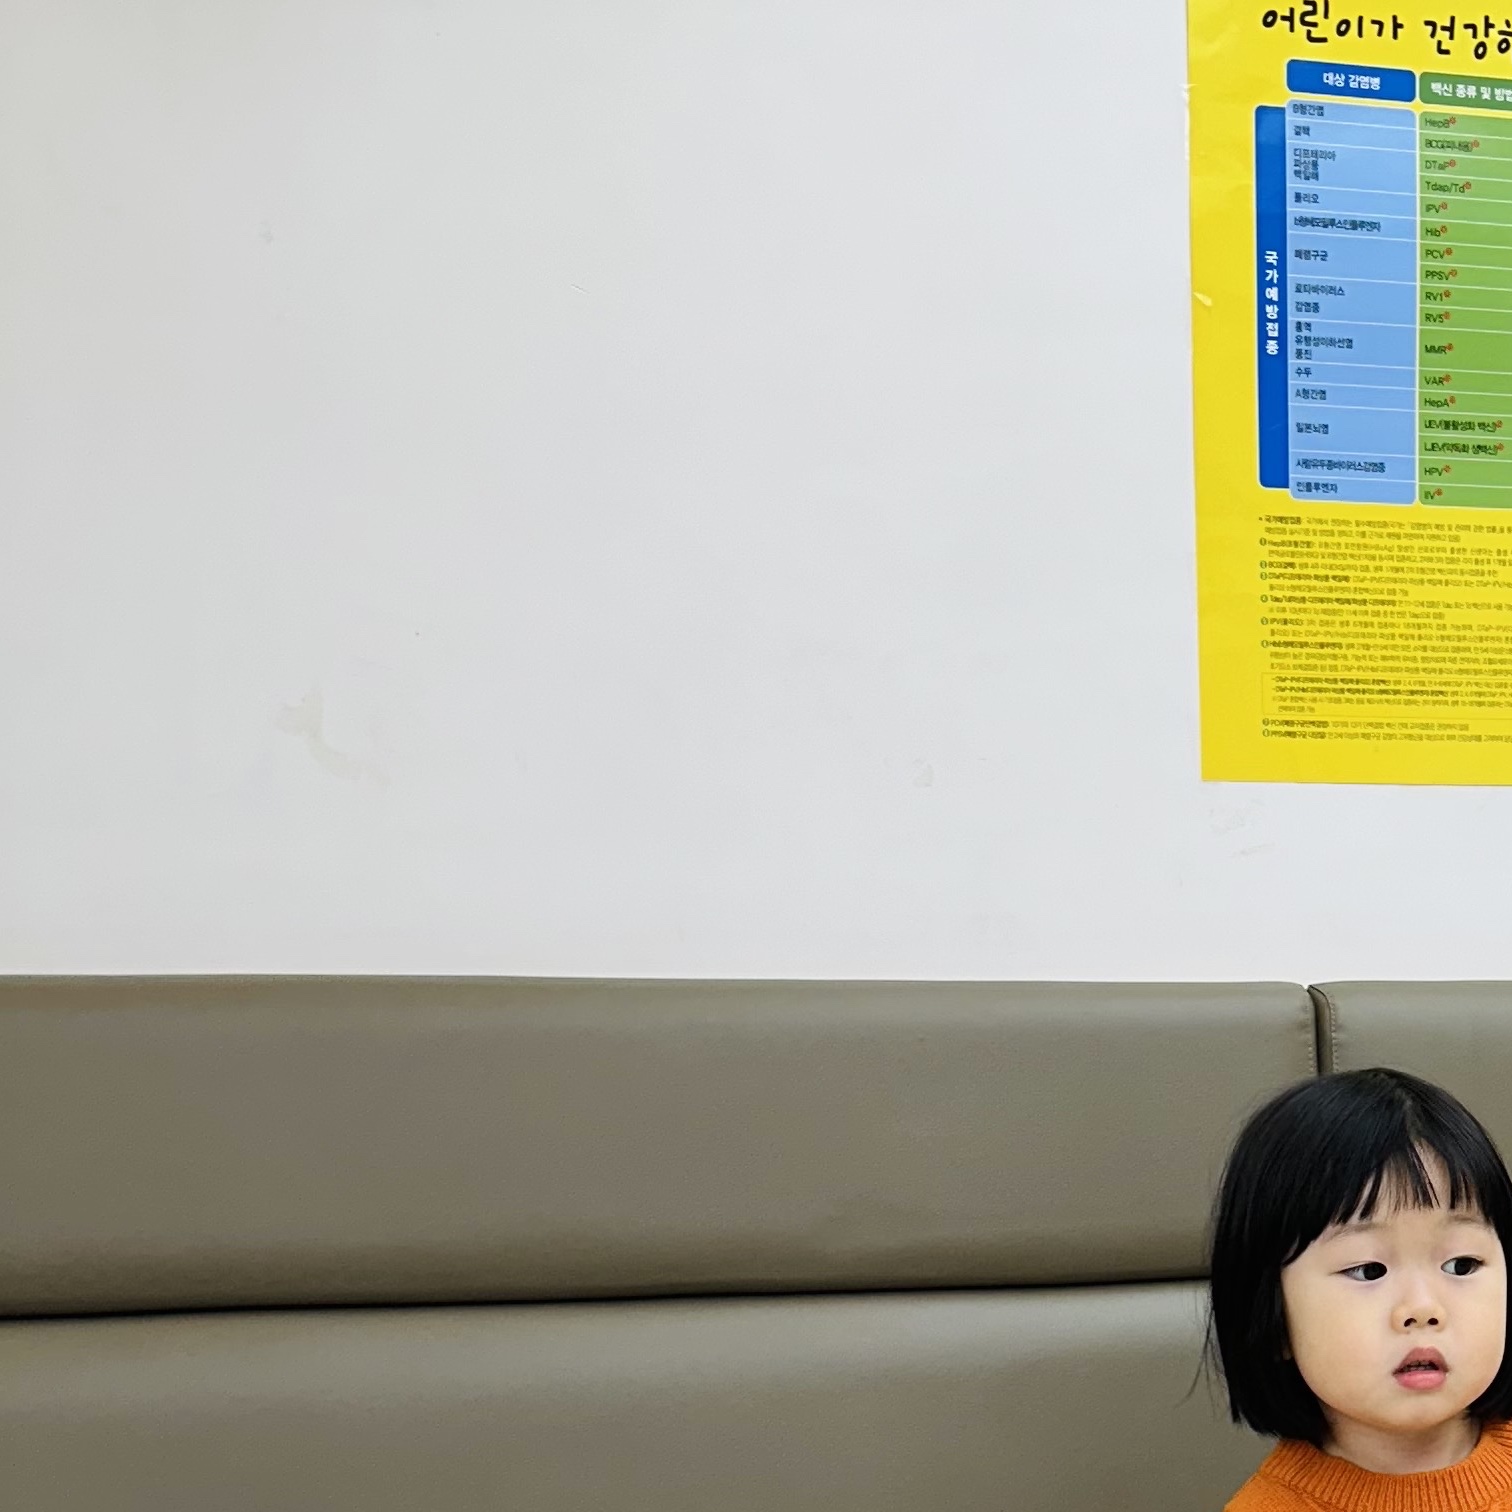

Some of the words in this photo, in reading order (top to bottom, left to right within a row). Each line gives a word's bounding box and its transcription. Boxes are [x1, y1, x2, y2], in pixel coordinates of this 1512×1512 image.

[1262, 0, 1403, 43] 어린이가
[1323, 72, 1345, 88] 대상
[1348, 74, 1381, 91] 감염병
[1430, 82, 1453, 96] 백신
[1455, 85, 1477, 99] 종류
